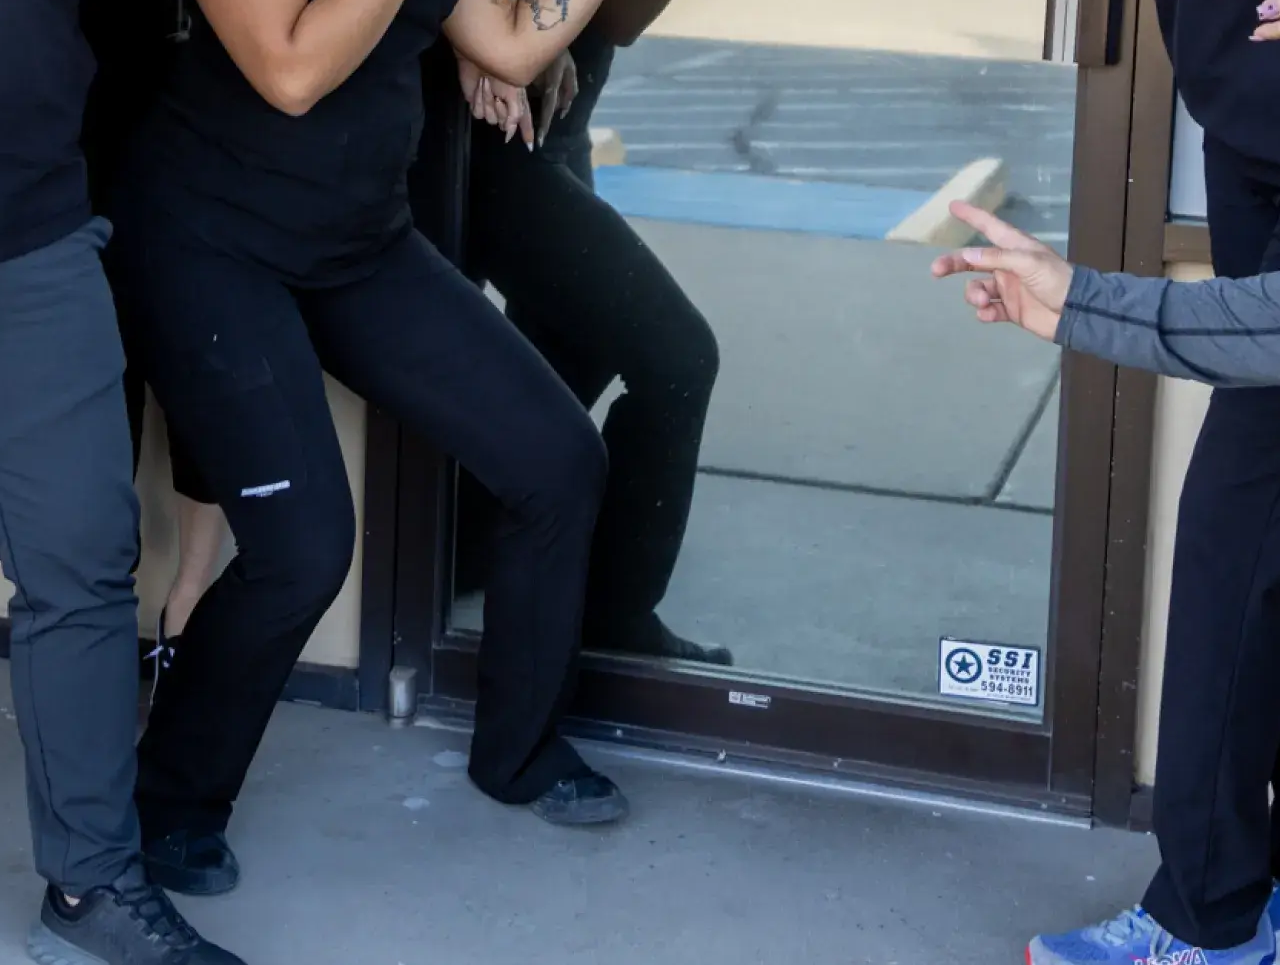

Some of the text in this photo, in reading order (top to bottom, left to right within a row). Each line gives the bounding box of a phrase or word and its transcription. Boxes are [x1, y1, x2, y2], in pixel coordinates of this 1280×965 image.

[986, 649, 1034, 669] SSI
[987, 667, 1031, 678] SECURITY
[989, 675, 1030, 684] SYSTEMS
[981, 681, 1033, 697] 594-8911
